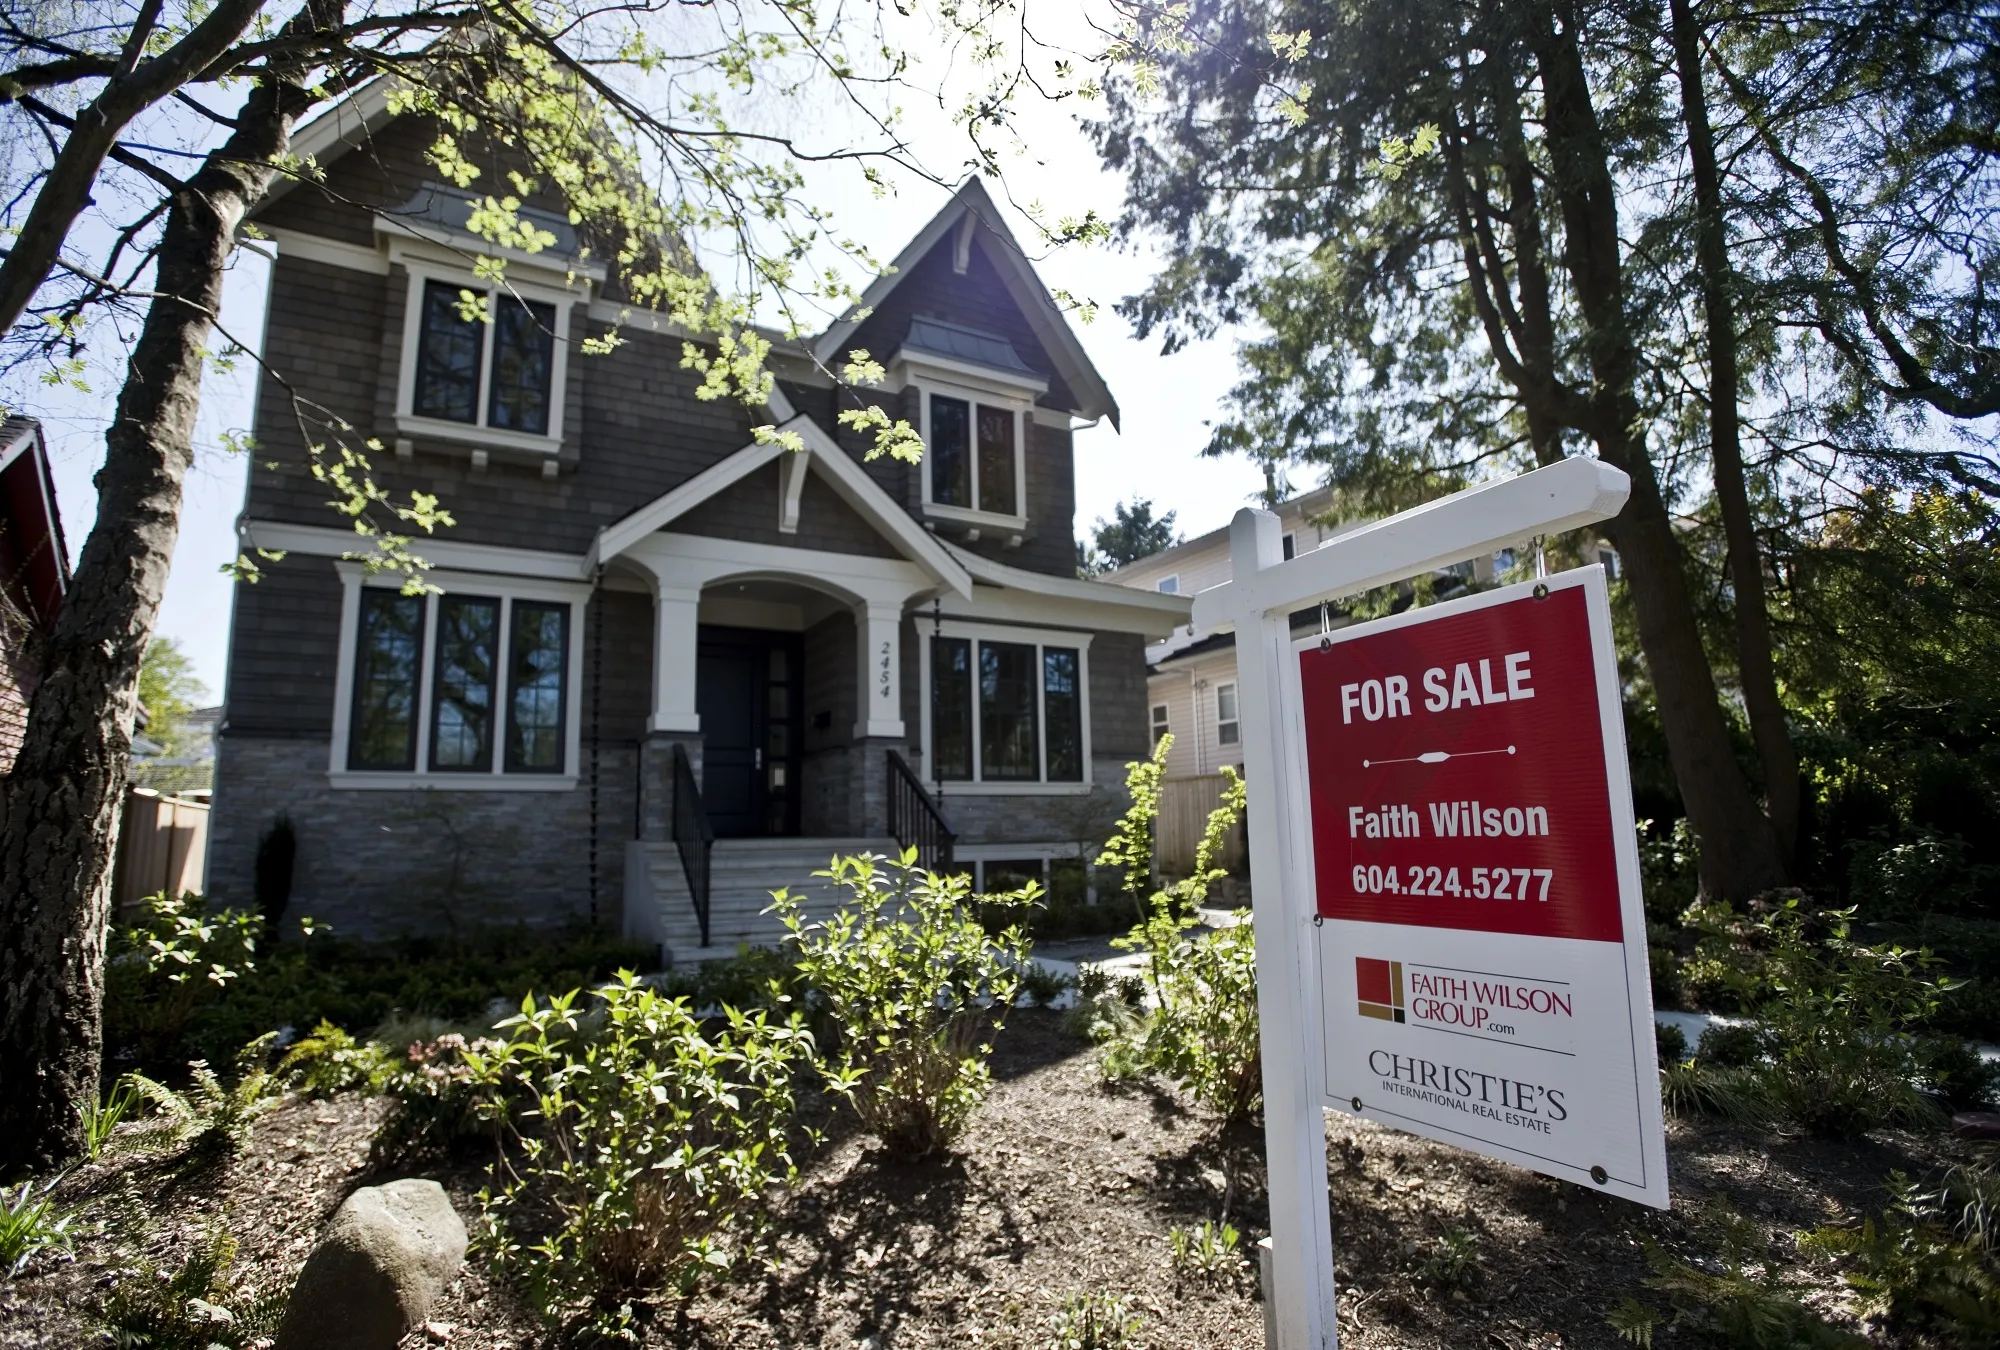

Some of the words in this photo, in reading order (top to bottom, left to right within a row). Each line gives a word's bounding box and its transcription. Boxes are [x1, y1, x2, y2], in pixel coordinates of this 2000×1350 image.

[880, 641, 890, 698] 2454
[1340, 674, 1412, 724] FOR
[1422, 651, 1535, 713] SALE
[1349, 804, 1420, 838] Faith
[1428, 800, 1549, 837] Wilson
[1352, 864, 1553, 902] 604.224.5277
[1411, 972, 1468, 1001] FAITH
[1472, 981, 1573, 1018] WILSON
[1368, 1049, 1568, 1121] CHRISTIE'S
[1382, 1080, 1470, 1114] INTERNATIONAL
[1472, 1104, 1503, 1122] REAL
[1505, 1112, 1552, 1135] ESTATE
